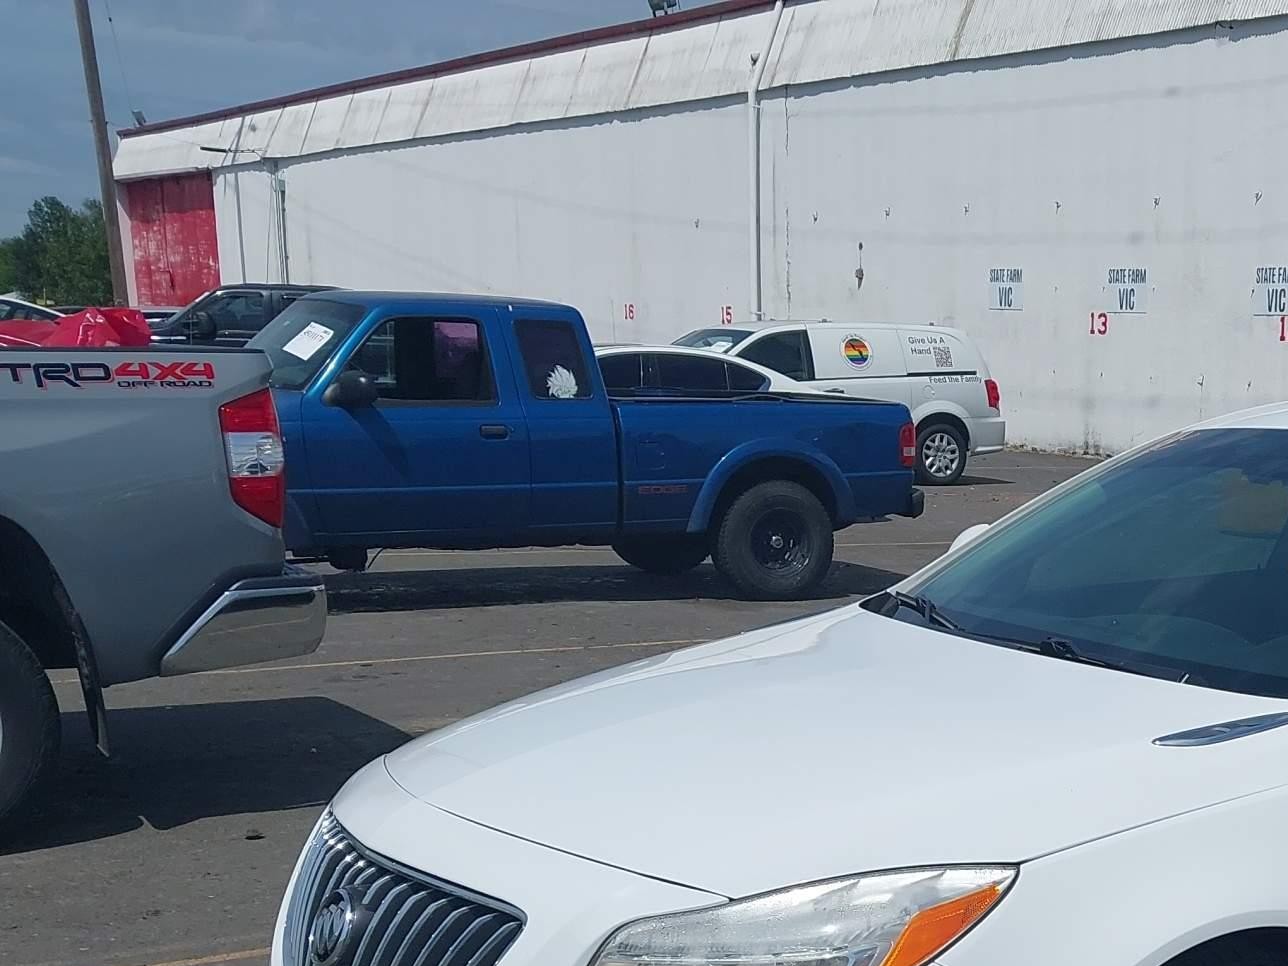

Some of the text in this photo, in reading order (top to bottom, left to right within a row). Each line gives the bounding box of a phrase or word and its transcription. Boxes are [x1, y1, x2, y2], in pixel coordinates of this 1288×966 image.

[989, 268, 1023, 283] STATE FARM
[1108, 268, 1147, 284] STATE FARM
[1256, 267, 1276, 284] STATE
[998, 286, 1013, 308] VIC
[1118, 287, 1135, 311] VIC
[1267, 288, 1287, 313] VIC
[624, 303, 635, 320] 16
[721, 306, 733, 324] 15
[1089, 312, 1108, 335] 13
[907, 336, 946, 345] Give Us A
[910, 347, 932, 355] Hand
[0, 362, 114, 388] TRD
[928, 376, 947, 384] Feed
[960, 375, 982, 384] Family
[117, 380, 212, 388] OFF ROAD
[639, 485, 688, 494] EDGE
